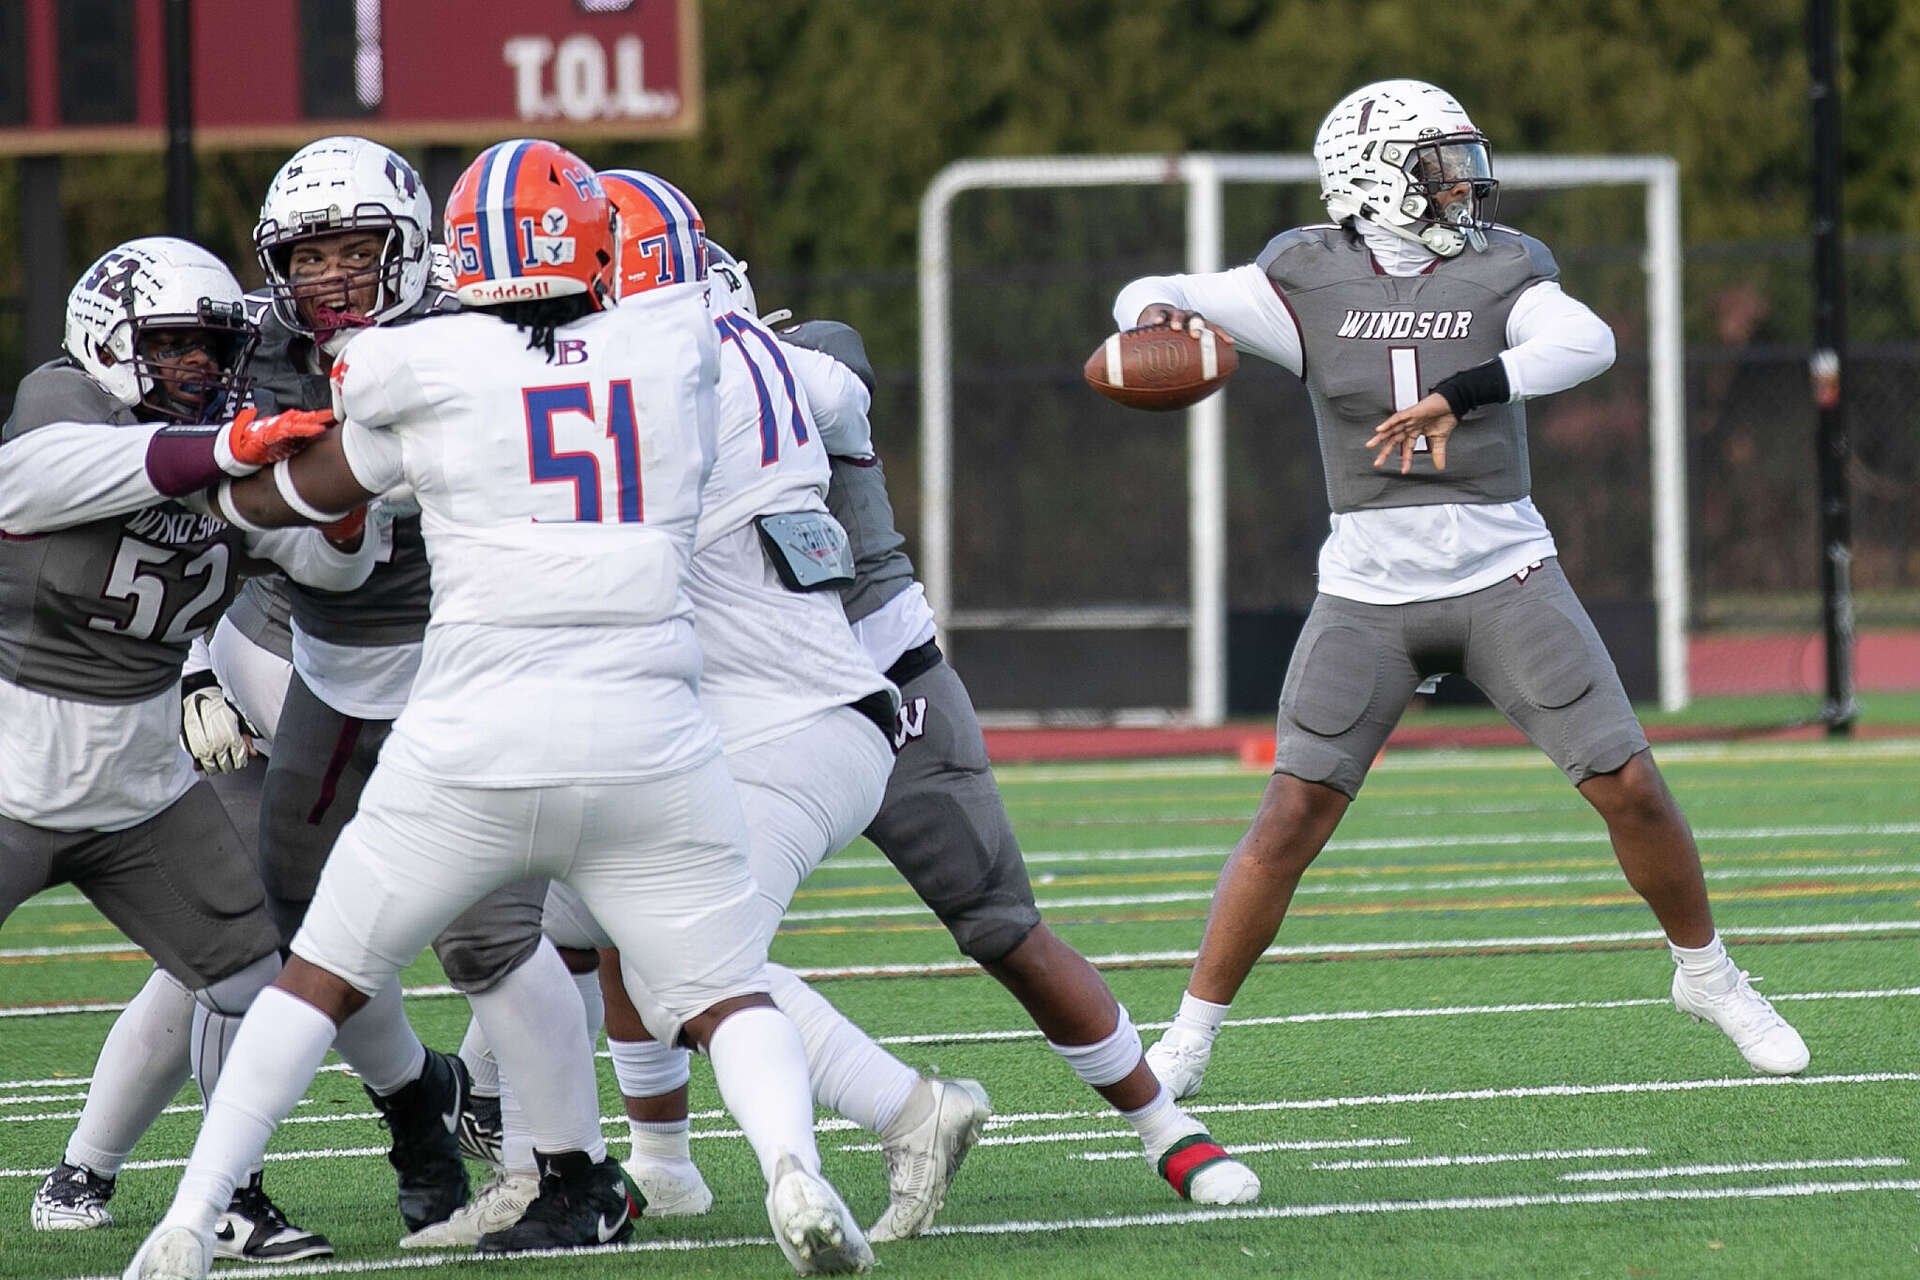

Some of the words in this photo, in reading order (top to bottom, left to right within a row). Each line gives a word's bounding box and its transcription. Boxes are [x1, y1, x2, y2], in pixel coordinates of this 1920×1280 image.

[503, 35, 679, 120] T.O.L.
[1357, 100, 1376, 135] 1
[85, 253, 141, 300] 52
[471, 281, 549, 300] Riddell
[1336, 310, 1473, 339] WINDSOR
[554, 339, 589, 366] B
[1388, 346, 1431, 455] 1
[521, 379, 644, 524] 51
[88, 535, 229, 643] 52
